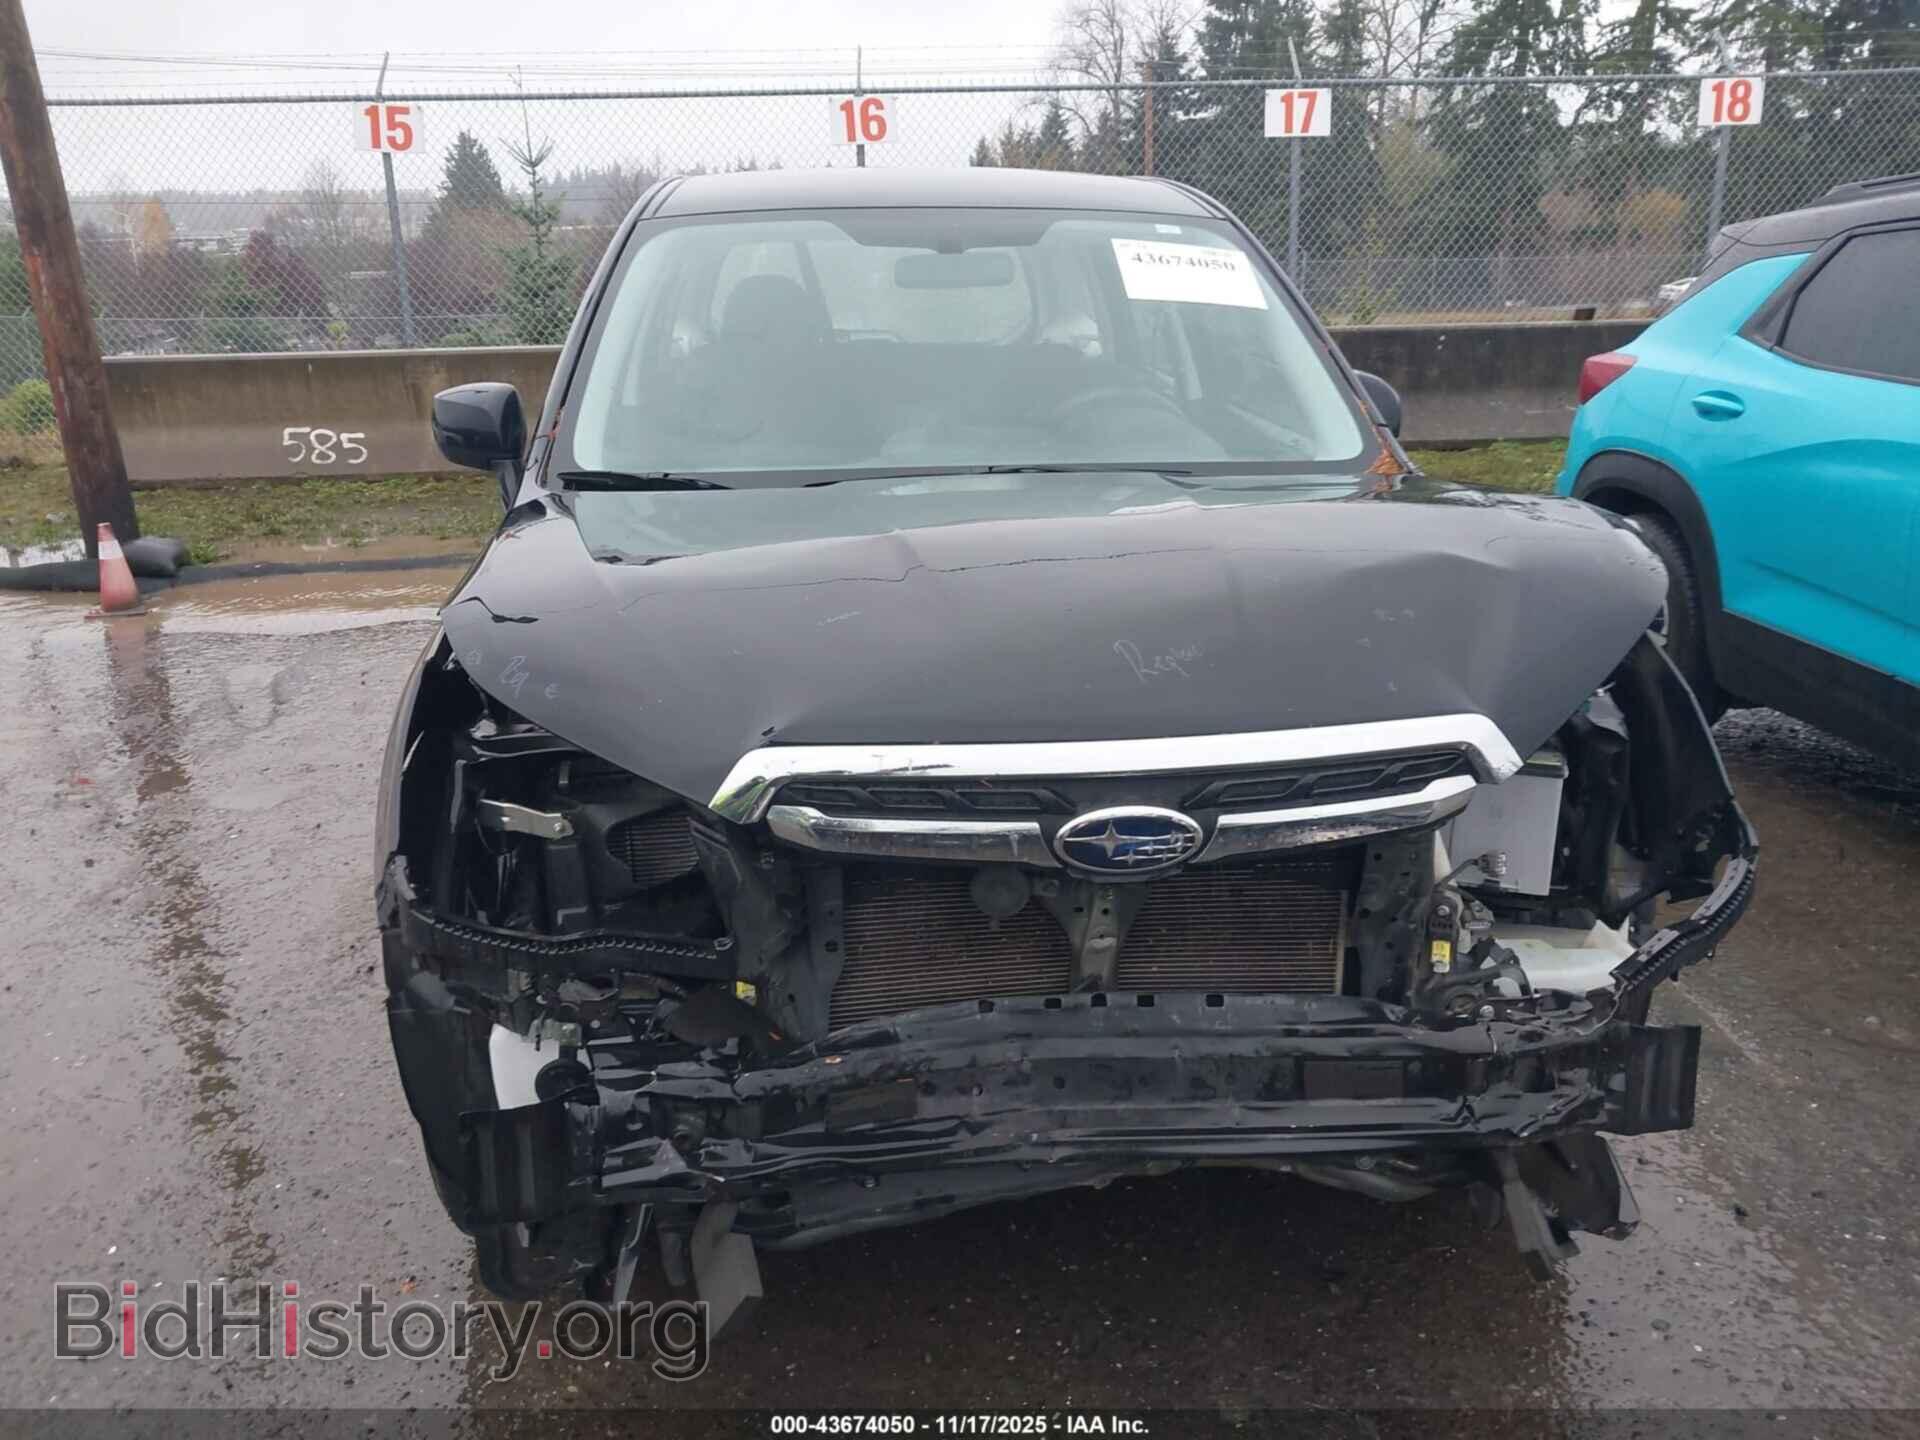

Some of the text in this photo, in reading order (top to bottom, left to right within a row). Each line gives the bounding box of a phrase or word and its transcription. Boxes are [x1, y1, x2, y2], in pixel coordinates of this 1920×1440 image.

[841, 97, 887, 143] 16
[1281, 90, 1319, 134] 17
[1711, 79, 1752, 123] 18
[364, 105, 414, 152] 15
[1130, 251, 1237, 272] 43674050
[282, 426, 368, 465] 585
